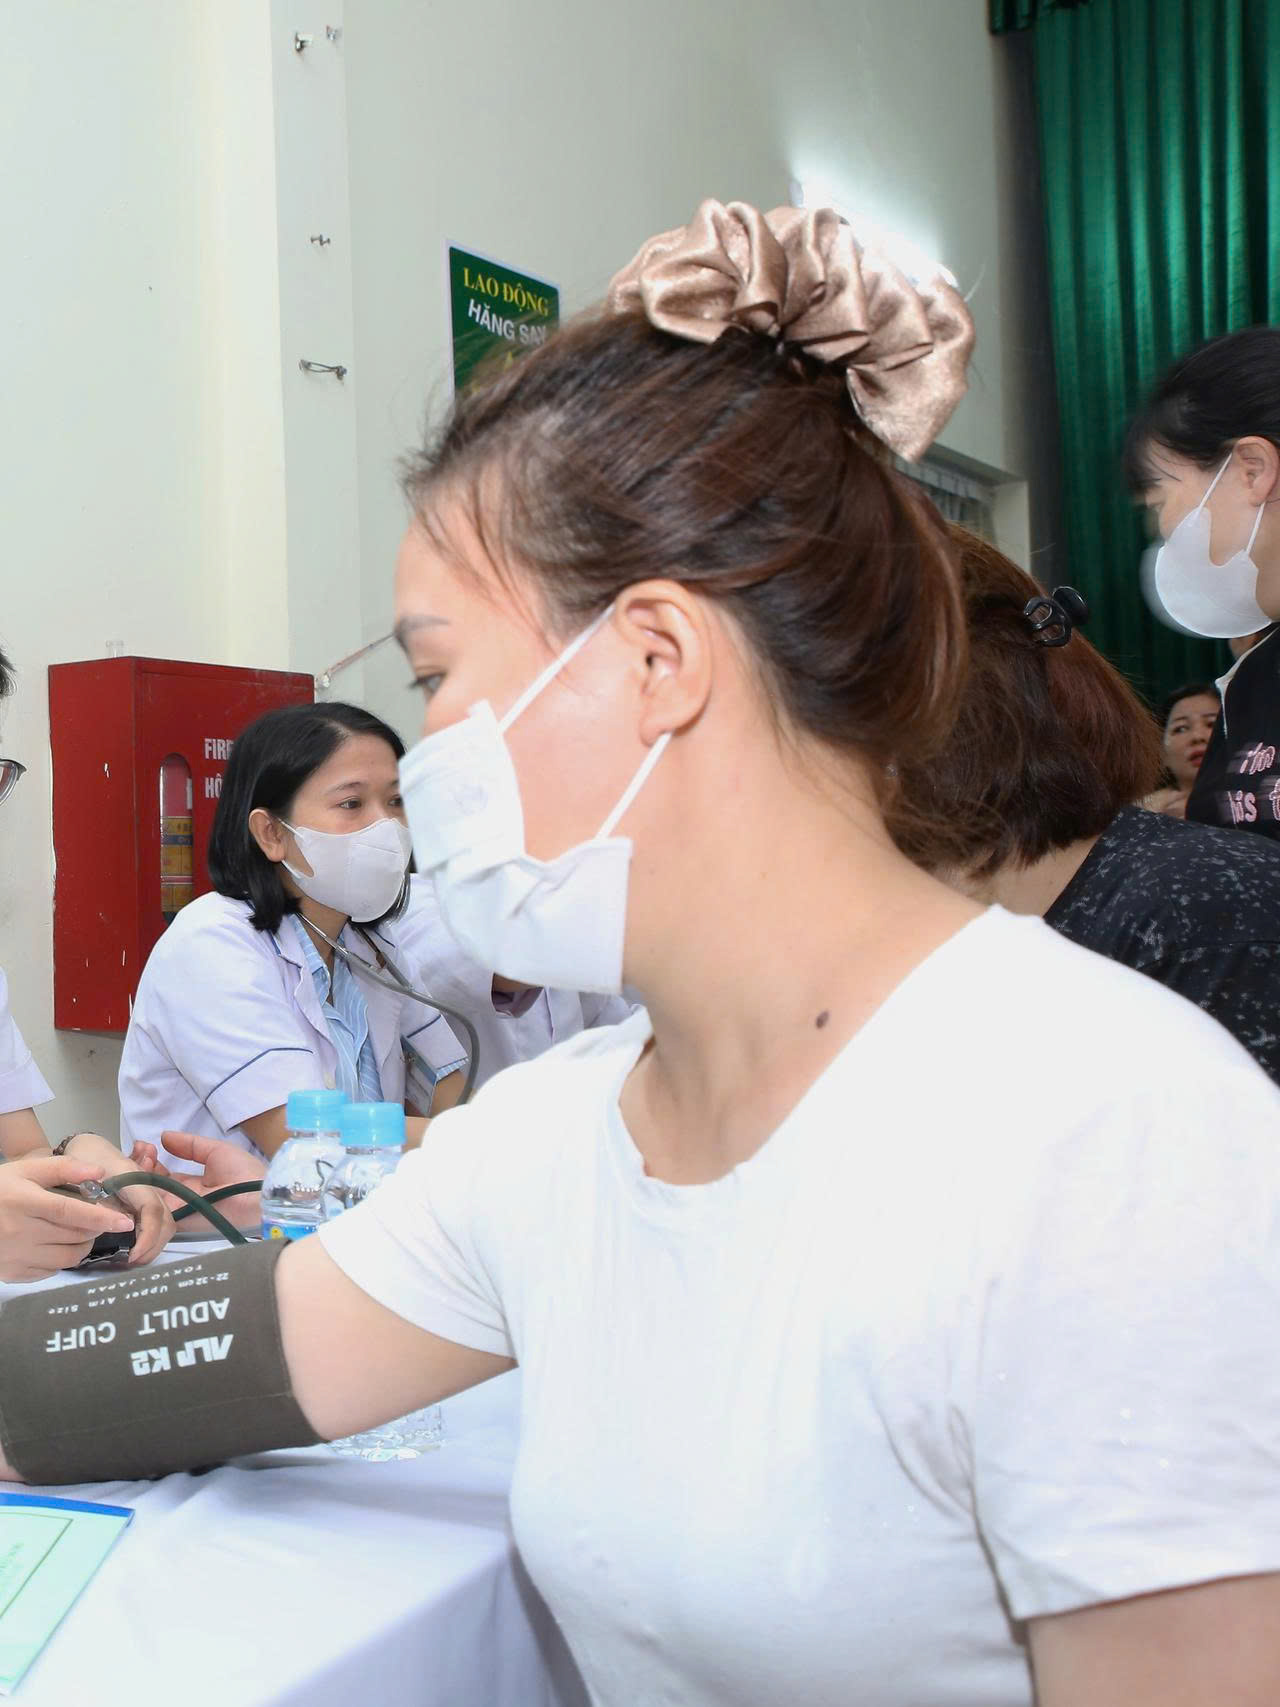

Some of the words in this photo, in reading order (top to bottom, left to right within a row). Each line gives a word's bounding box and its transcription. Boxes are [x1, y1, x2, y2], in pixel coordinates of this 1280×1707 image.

[463, 266, 499, 297] LAO
[503, 283, 549, 317] ĐỘNG
[468, 298, 516, 342] HĂNG
[150, 1264, 203, 1281] TOKYO
[87, 1278, 137, 1295] JAPAN
[124, 1284, 169, 1300] Upper
[47, 1304, 79, 1315] Size
[88, 1296, 116, 1308] Arm
[137, 1297, 231, 1337] ADULT
[45, 1321, 117, 1353] CUFF
